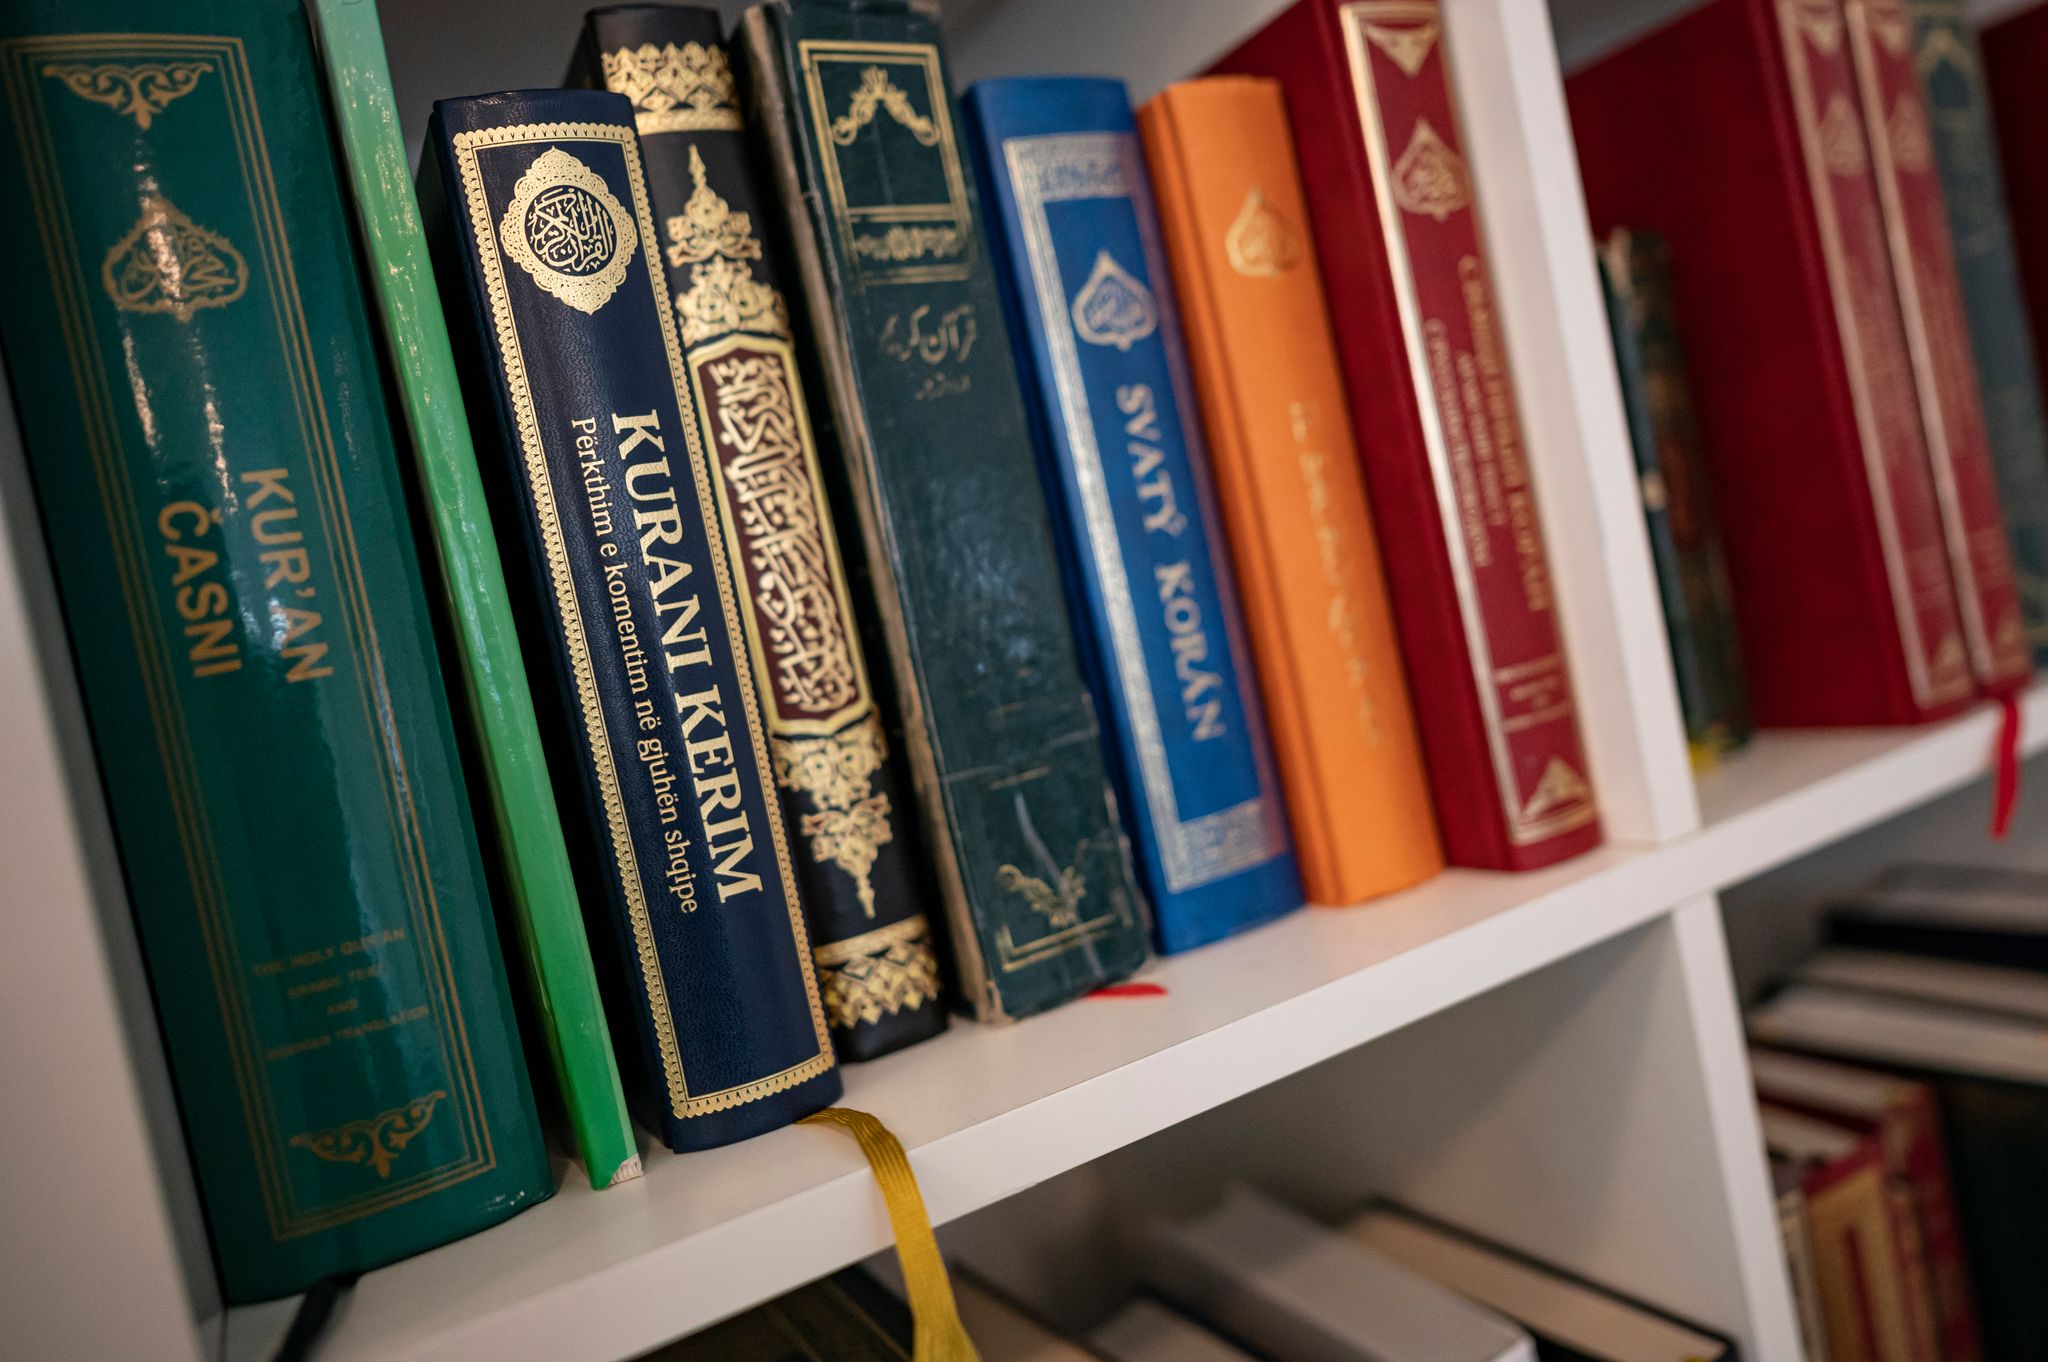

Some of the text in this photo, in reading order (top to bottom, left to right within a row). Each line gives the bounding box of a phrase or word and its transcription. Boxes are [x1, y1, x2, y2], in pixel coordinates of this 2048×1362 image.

[157, 500, 243, 678] ČASNI
[571, 416, 698, 914] Përkthim e komentim në gjuhën shqipe
[611, 408, 763, 904] KURANI KERIM
[1115, 382, 1188, 537] SVATÝ
[1153, 559, 1227, 742] KORÁN
